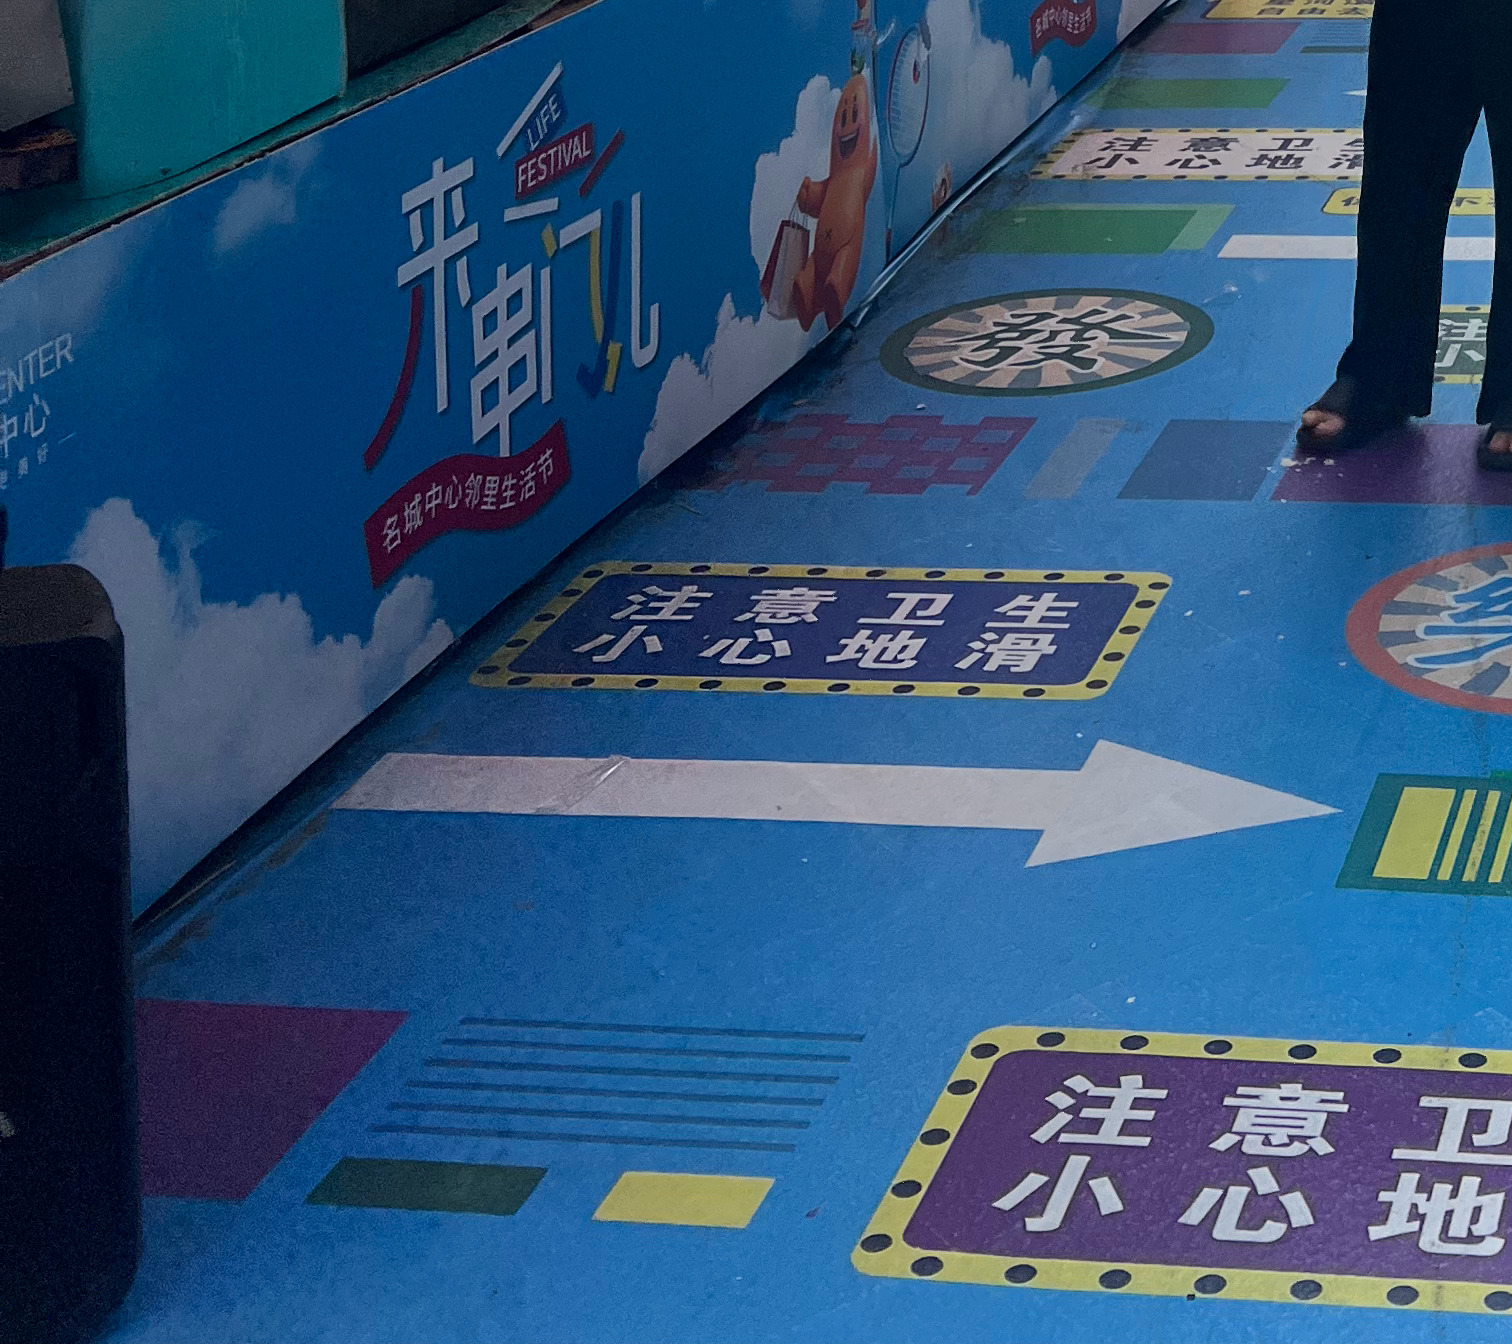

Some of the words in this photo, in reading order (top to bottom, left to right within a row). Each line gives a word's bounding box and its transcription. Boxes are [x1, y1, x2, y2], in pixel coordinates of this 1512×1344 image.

[526, 94, 562, 151] LIFE
[517, 132, 592, 190] FESTIVAL
[364, 157, 660, 471] 来串门儿
[382, 448, 555, 554] 名城中心邻里生活节
[610, 584, 1082, 631] 注意卫生
[572, 625, 1059, 674] 小心地滑
[991, 1154, 1506, 1256] 小心地
